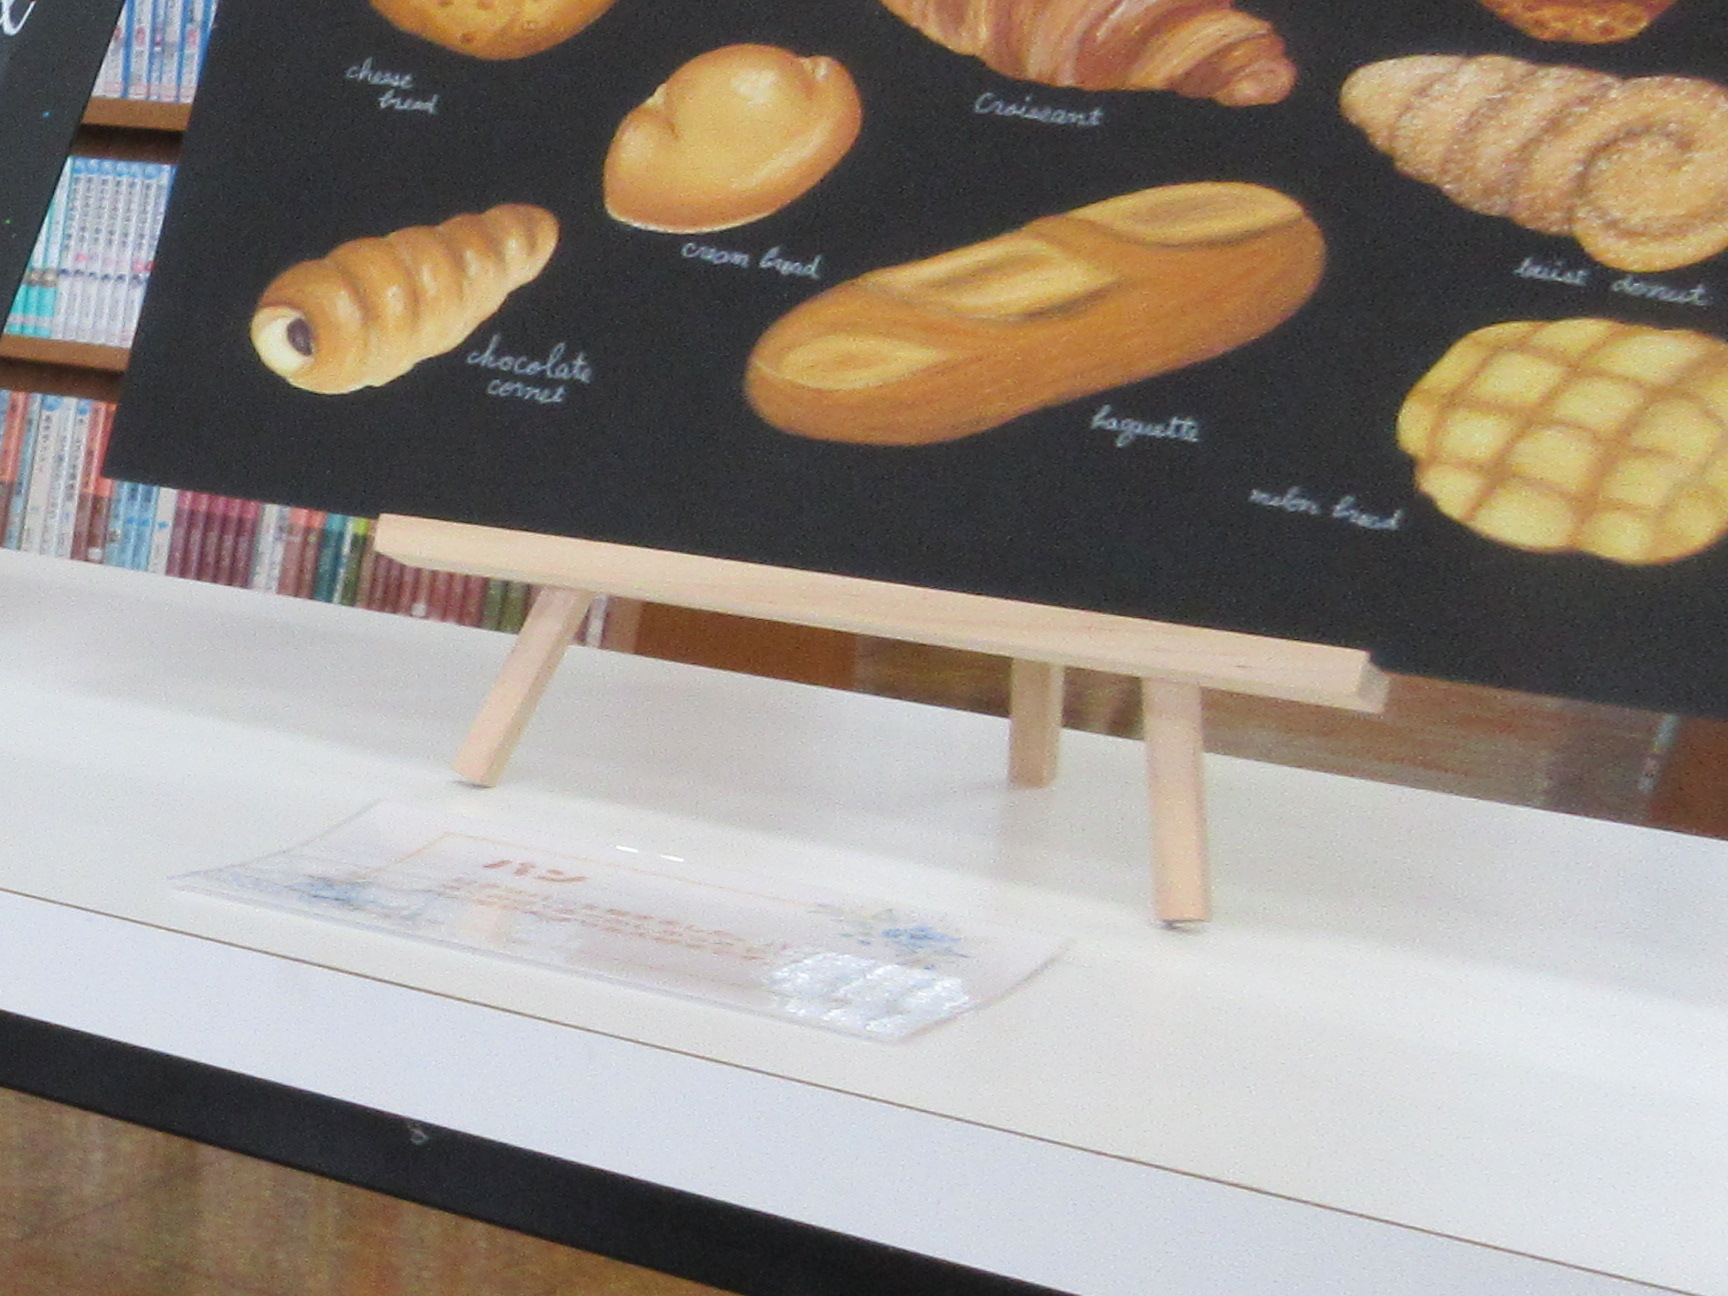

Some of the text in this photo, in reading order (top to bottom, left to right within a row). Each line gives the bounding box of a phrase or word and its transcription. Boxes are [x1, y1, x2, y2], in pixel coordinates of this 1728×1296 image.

[346, 57, 413, 89] cheese
[379, 89, 441, 116] bread
[757, 244, 822, 280] bread
[1609, 273, 1712, 306] donut
[466, 334, 593, 385] chocolate
